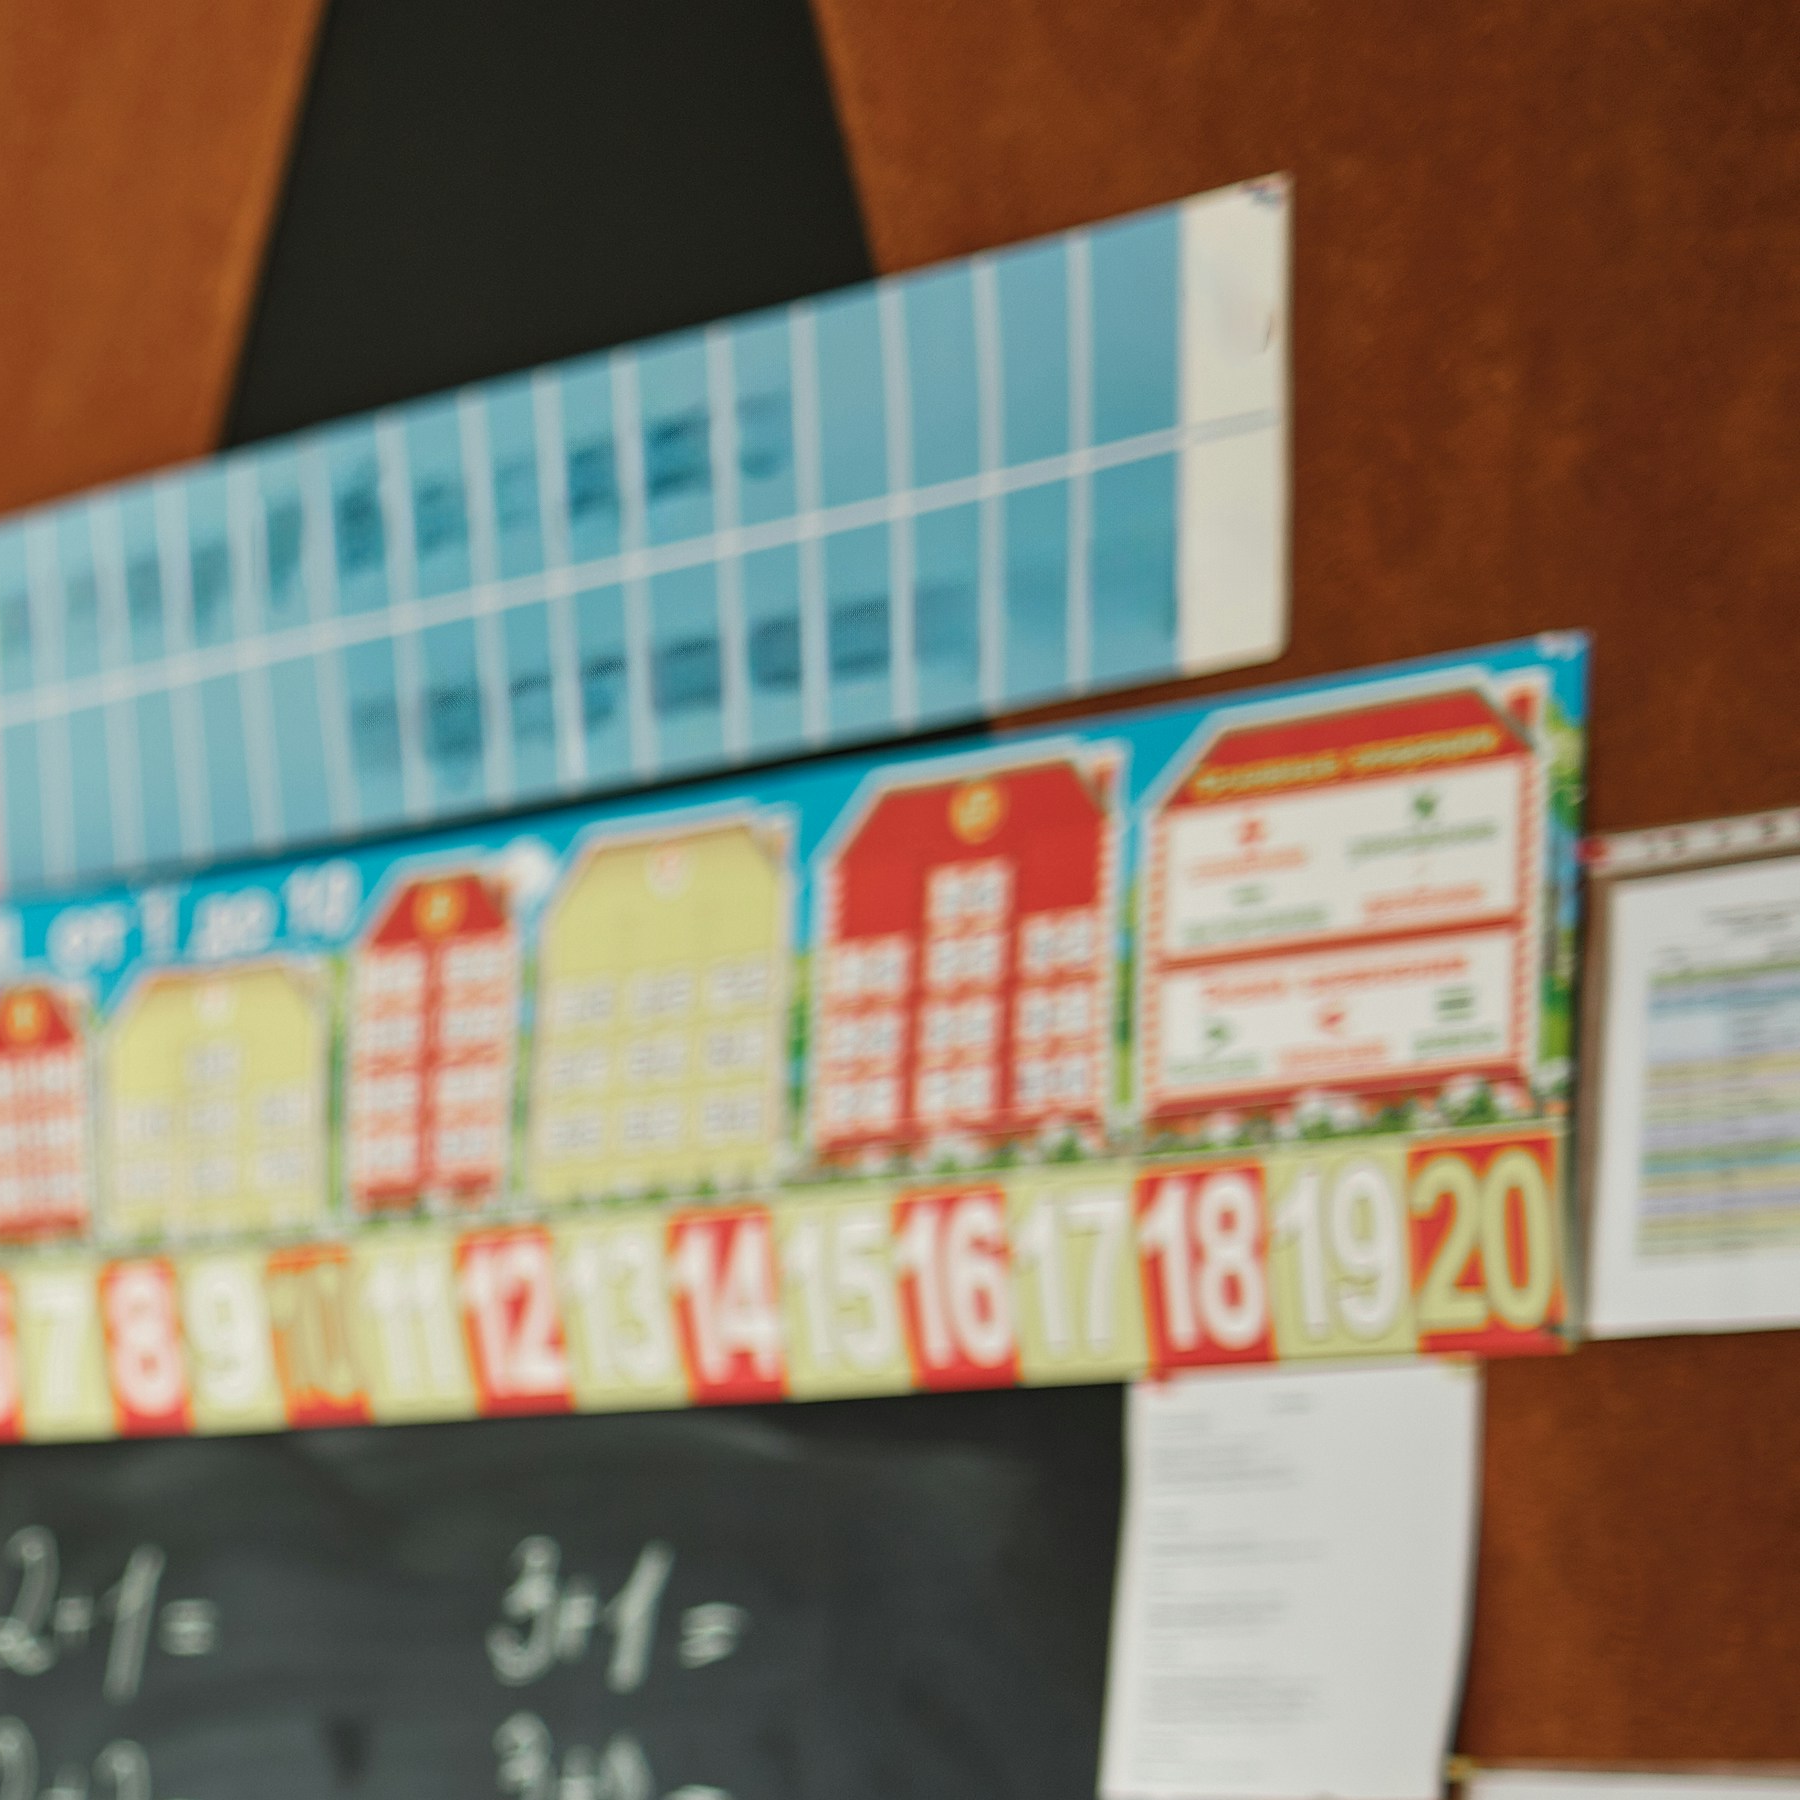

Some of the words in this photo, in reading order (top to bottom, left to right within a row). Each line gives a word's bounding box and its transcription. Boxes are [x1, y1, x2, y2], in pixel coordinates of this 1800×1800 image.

[104, 1262, 186, 1420] 8
[188, 1258, 270, 1414] 9
[366, 1245, 456, 1400] 11
[460, 1236, 570, 1400] 12
[568, 1228, 676, 1390] 13
[673, 1211, 786, 1388] 14
[786, 1204, 898, 1372] 15
[896, 1196, 1014, 1370] 16
[1014, 1186, 1130, 1356] 17
[1138, 1168, 1270, 1353] 18
[1276, 1154, 1402, 1343] 19
[1410, 1145, 1560, 1334] 20
